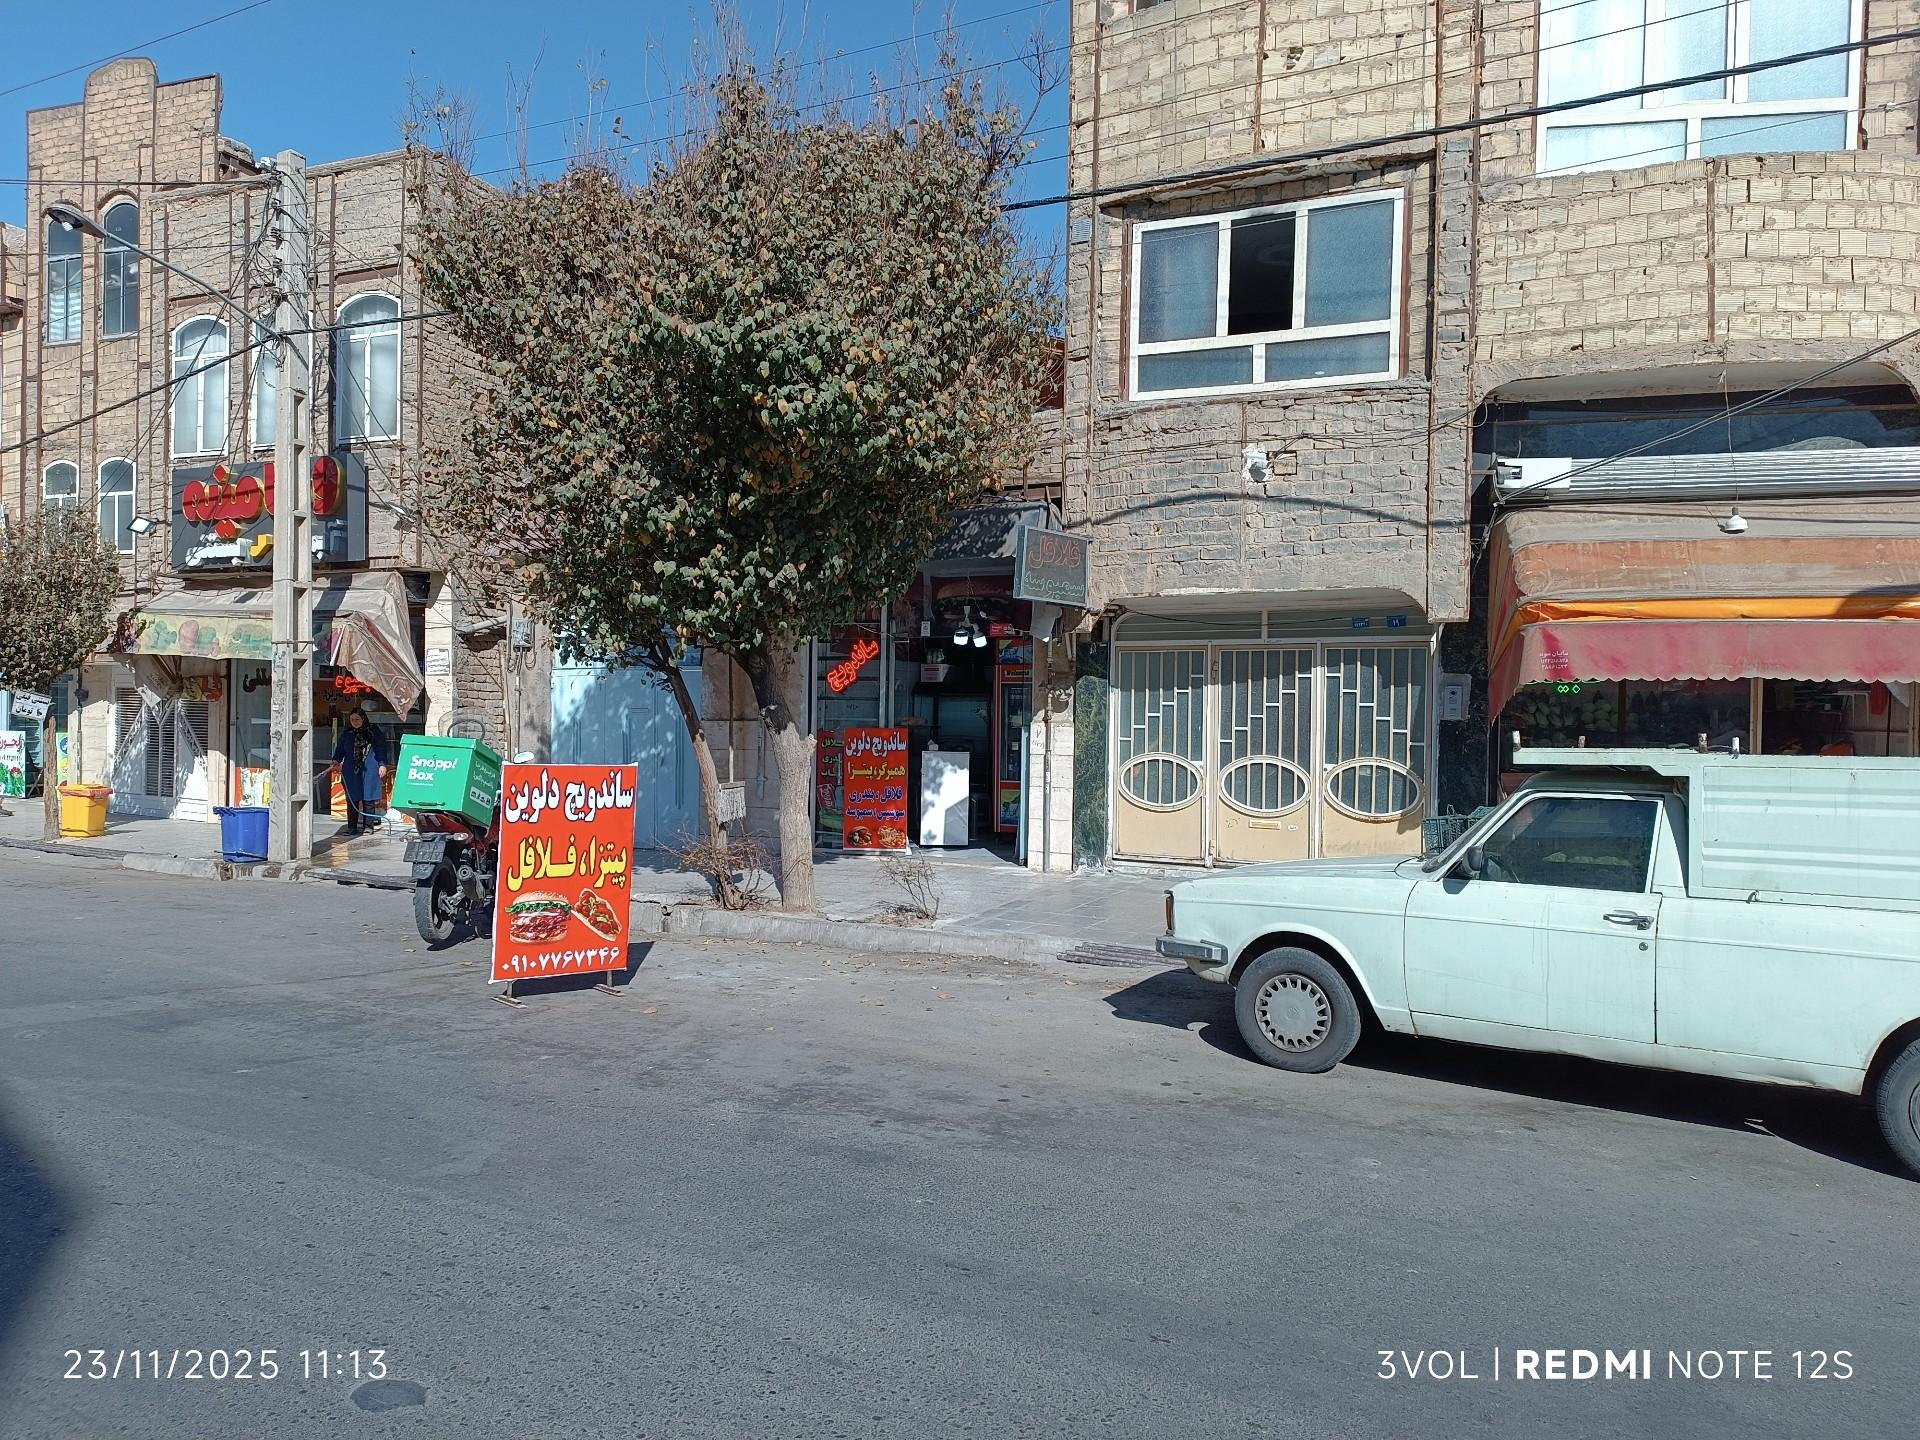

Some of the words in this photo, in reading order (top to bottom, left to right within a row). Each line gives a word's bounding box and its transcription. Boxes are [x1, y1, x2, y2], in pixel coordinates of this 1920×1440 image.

[1028, 535, 1081, 569] فلافل
[827, 639, 880, 692] ساندویچ
[15, 705, 33, 716] تومان
[845, 730, 871, 757] دلوین
[871, 730, 907, 757] ساندویچ
[408, 768, 434, 781] Box
[410, 755, 458, 771] Snapp!
[847, 761, 873, 780] پیتزا
[504, 768, 560, 823] دلوین
[564, 770, 634, 822] ساندویچ
[848, 787, 874, 804] بندری
[506, 834, 578, 892] فلافل
[501, 946, 620, 973] ۰۹۱۰۷۷۶۷۳۴۶
